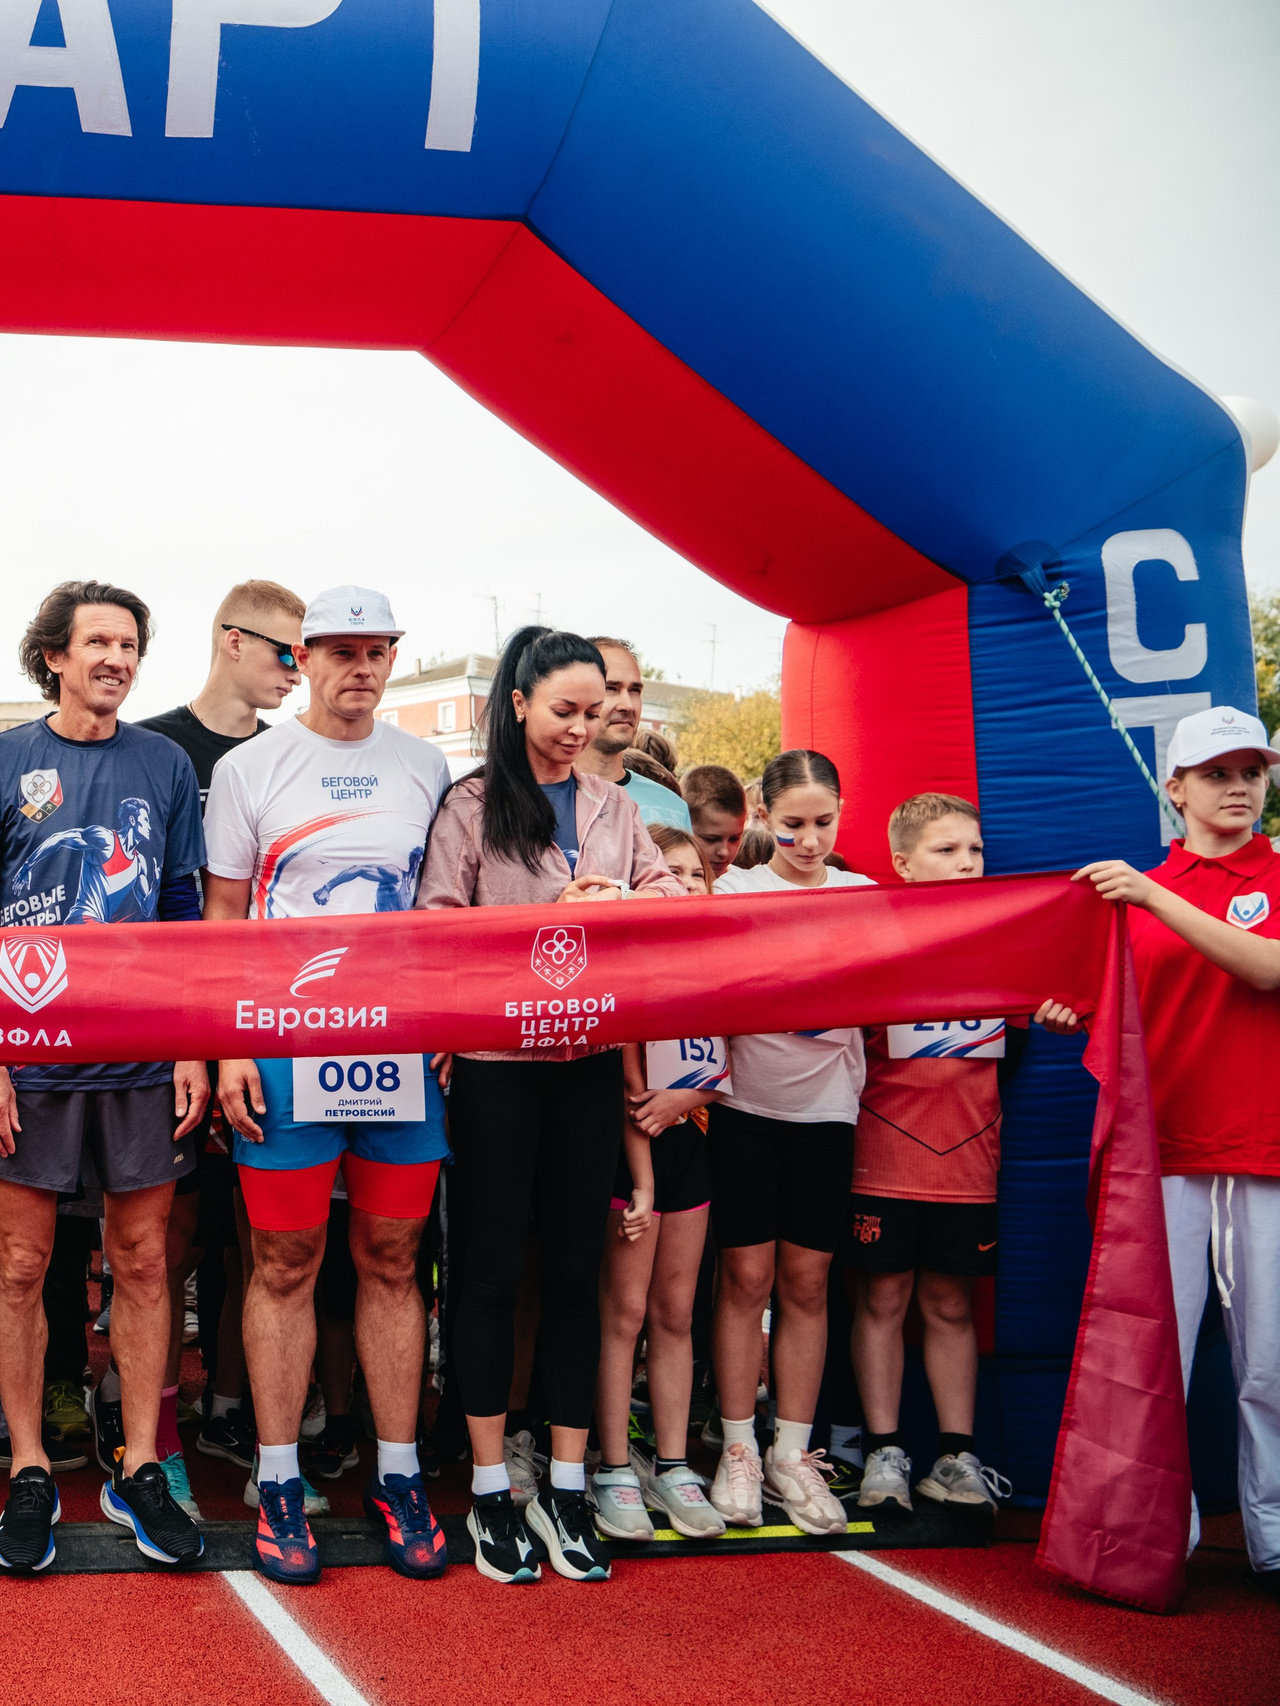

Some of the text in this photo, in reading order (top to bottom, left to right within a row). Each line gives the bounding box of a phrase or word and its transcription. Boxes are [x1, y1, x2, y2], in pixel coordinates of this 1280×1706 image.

[321, 774, 379, 788] БЕГОВОЙ
[331, 788, 373, 802] ЦЕНТР
[0, 884, 67, 926] БЕГОВЫЕ
[504, 993, 616, 1018] БЕГОВОЙ
[235, 1000, 388, 1037] Евразия
[520, 1016, 600, 1037] ЦЕНТР
[520, 1034, 588, 1049] ВФЛА
[679, 1037, 718, 1065] 152
[318, 1060, 401, 1092] 008
[324, 1107, 396, 1117] ПЕТРОВСКИЙ
[337, 1097, 382, 1107] ДМИТРИЙ
